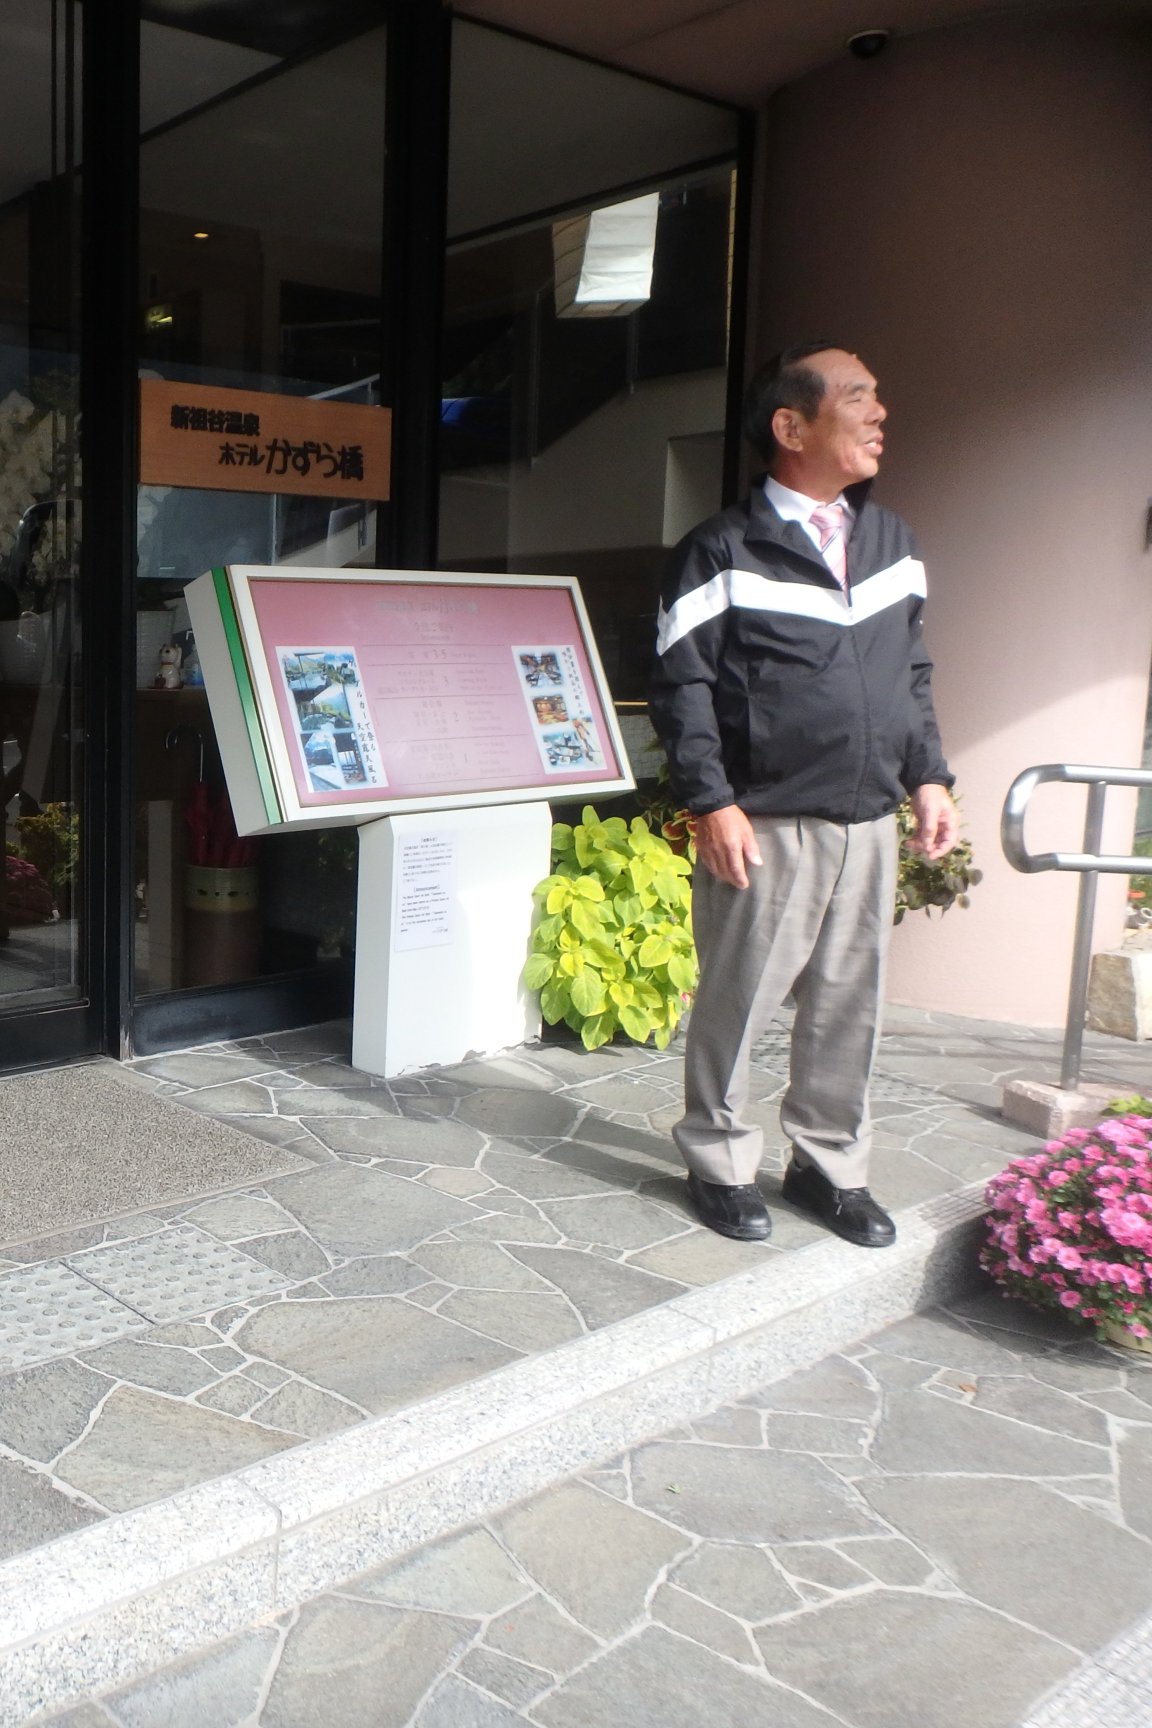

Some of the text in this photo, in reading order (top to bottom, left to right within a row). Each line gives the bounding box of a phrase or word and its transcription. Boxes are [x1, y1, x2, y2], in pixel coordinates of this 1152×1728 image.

[171, 404, 260, 437] 新祖谷温泉
[218, 438, 364, 481] ホテルかずら橋
